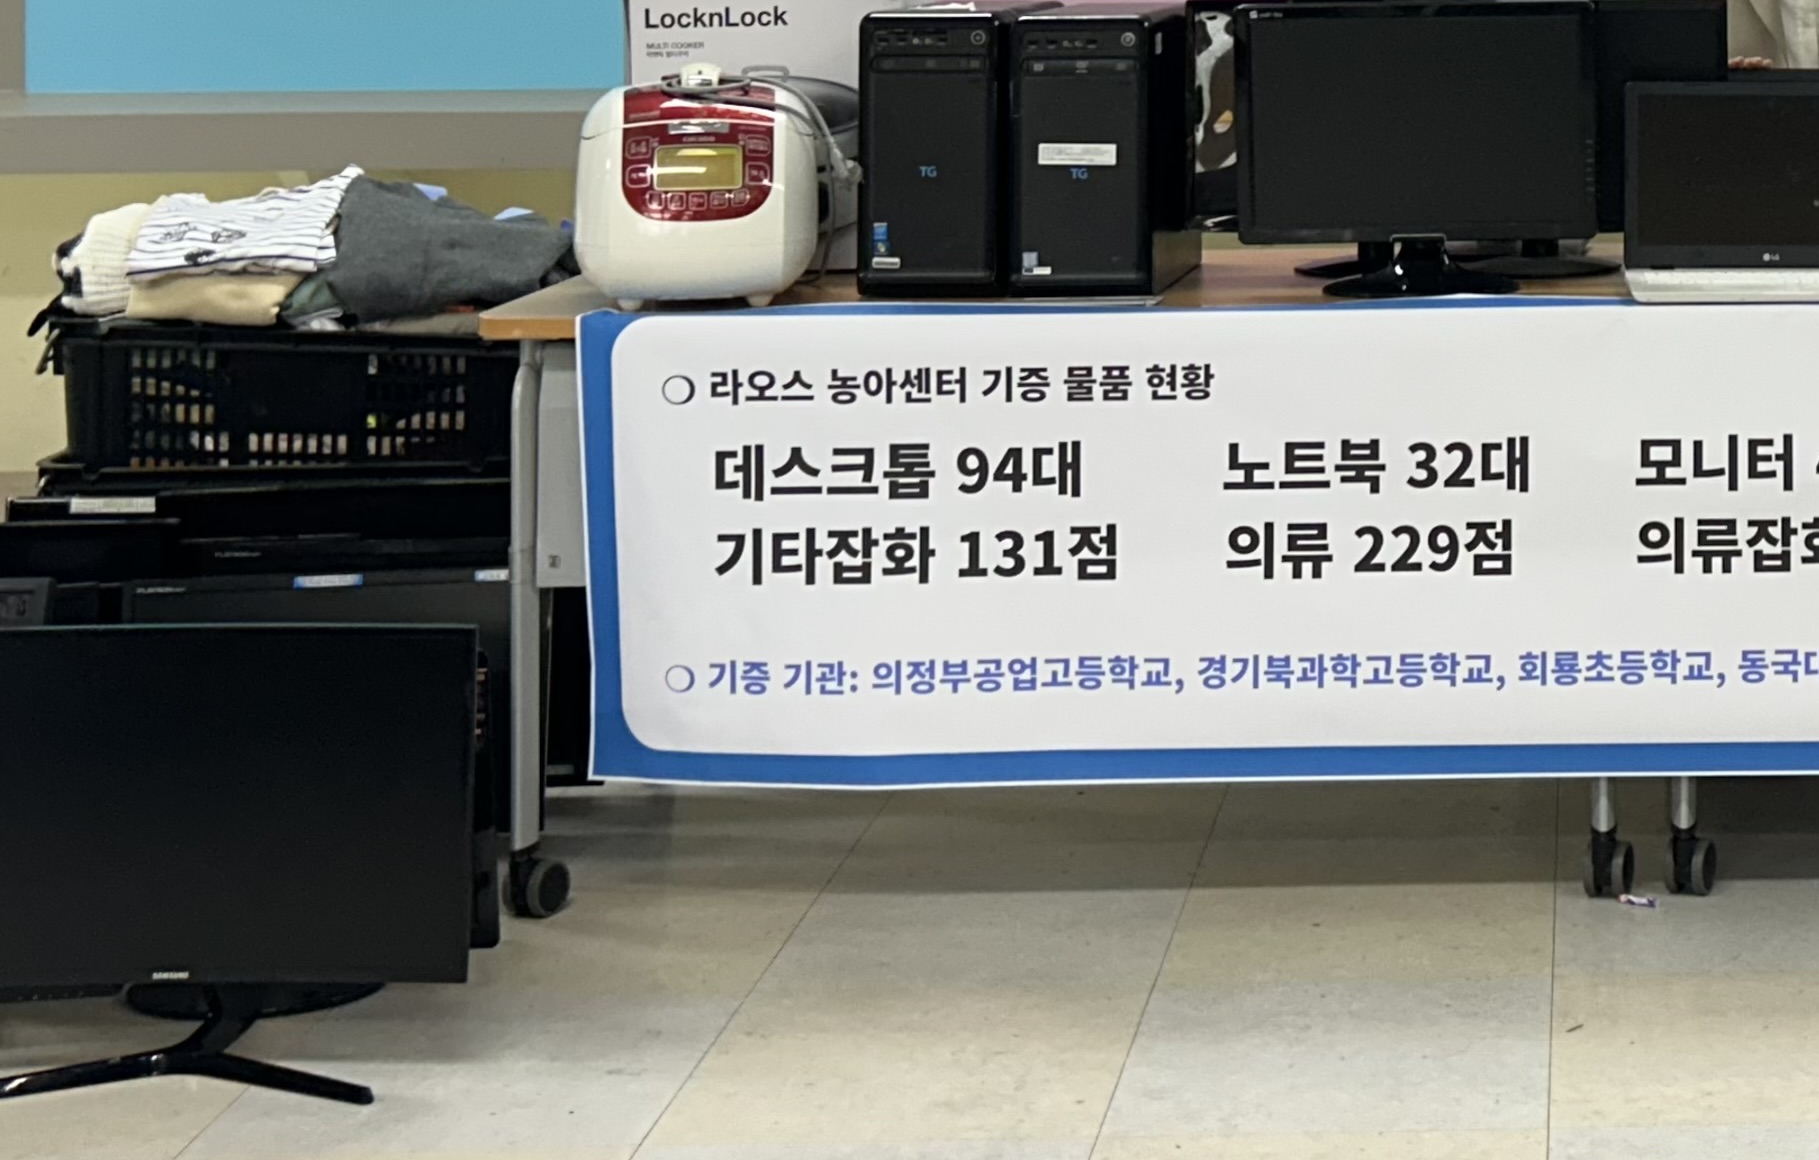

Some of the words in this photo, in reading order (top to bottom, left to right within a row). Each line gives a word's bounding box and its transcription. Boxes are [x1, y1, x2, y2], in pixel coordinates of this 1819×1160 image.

[644, 5, 789, 29] LocknLock
[919, 165, 938, 178] TG
[1070, 167, 1089, 180] TG
[710, 368, 815, 406] 라오스
[827, 366, 967, 405] 농아센터
[982, 366, 1051, 403] 기증
[1063, 365, 1133, 402] 물품
[1145, 363, 1215, 401] 현황
[715, 443, 936, 502] 데스크톱
[957, 440, 1082, 498] 94대
[1223, 438, 1387, 494] 노트북
[1406, 436, 1530, 493] 32대
[1635, 433, 1794, 492] 모니터
[714, 525, 936, 586] 기타잡화
[958, 523, 1118, 581] 131점
[1226, 521, 1334, 580] 의류
[1354, 518, 1514, 576] 229점
[708, 660, 771, 695] 기증
[784, 660, 859, 695] 기관:
[872, 655, 1185, 695] 의정부공업고등학교,
[1198, 651, 1505, 691] 경기북과학고등학교,
[1518, 648, 1726, 689] 회룡초등학교,
